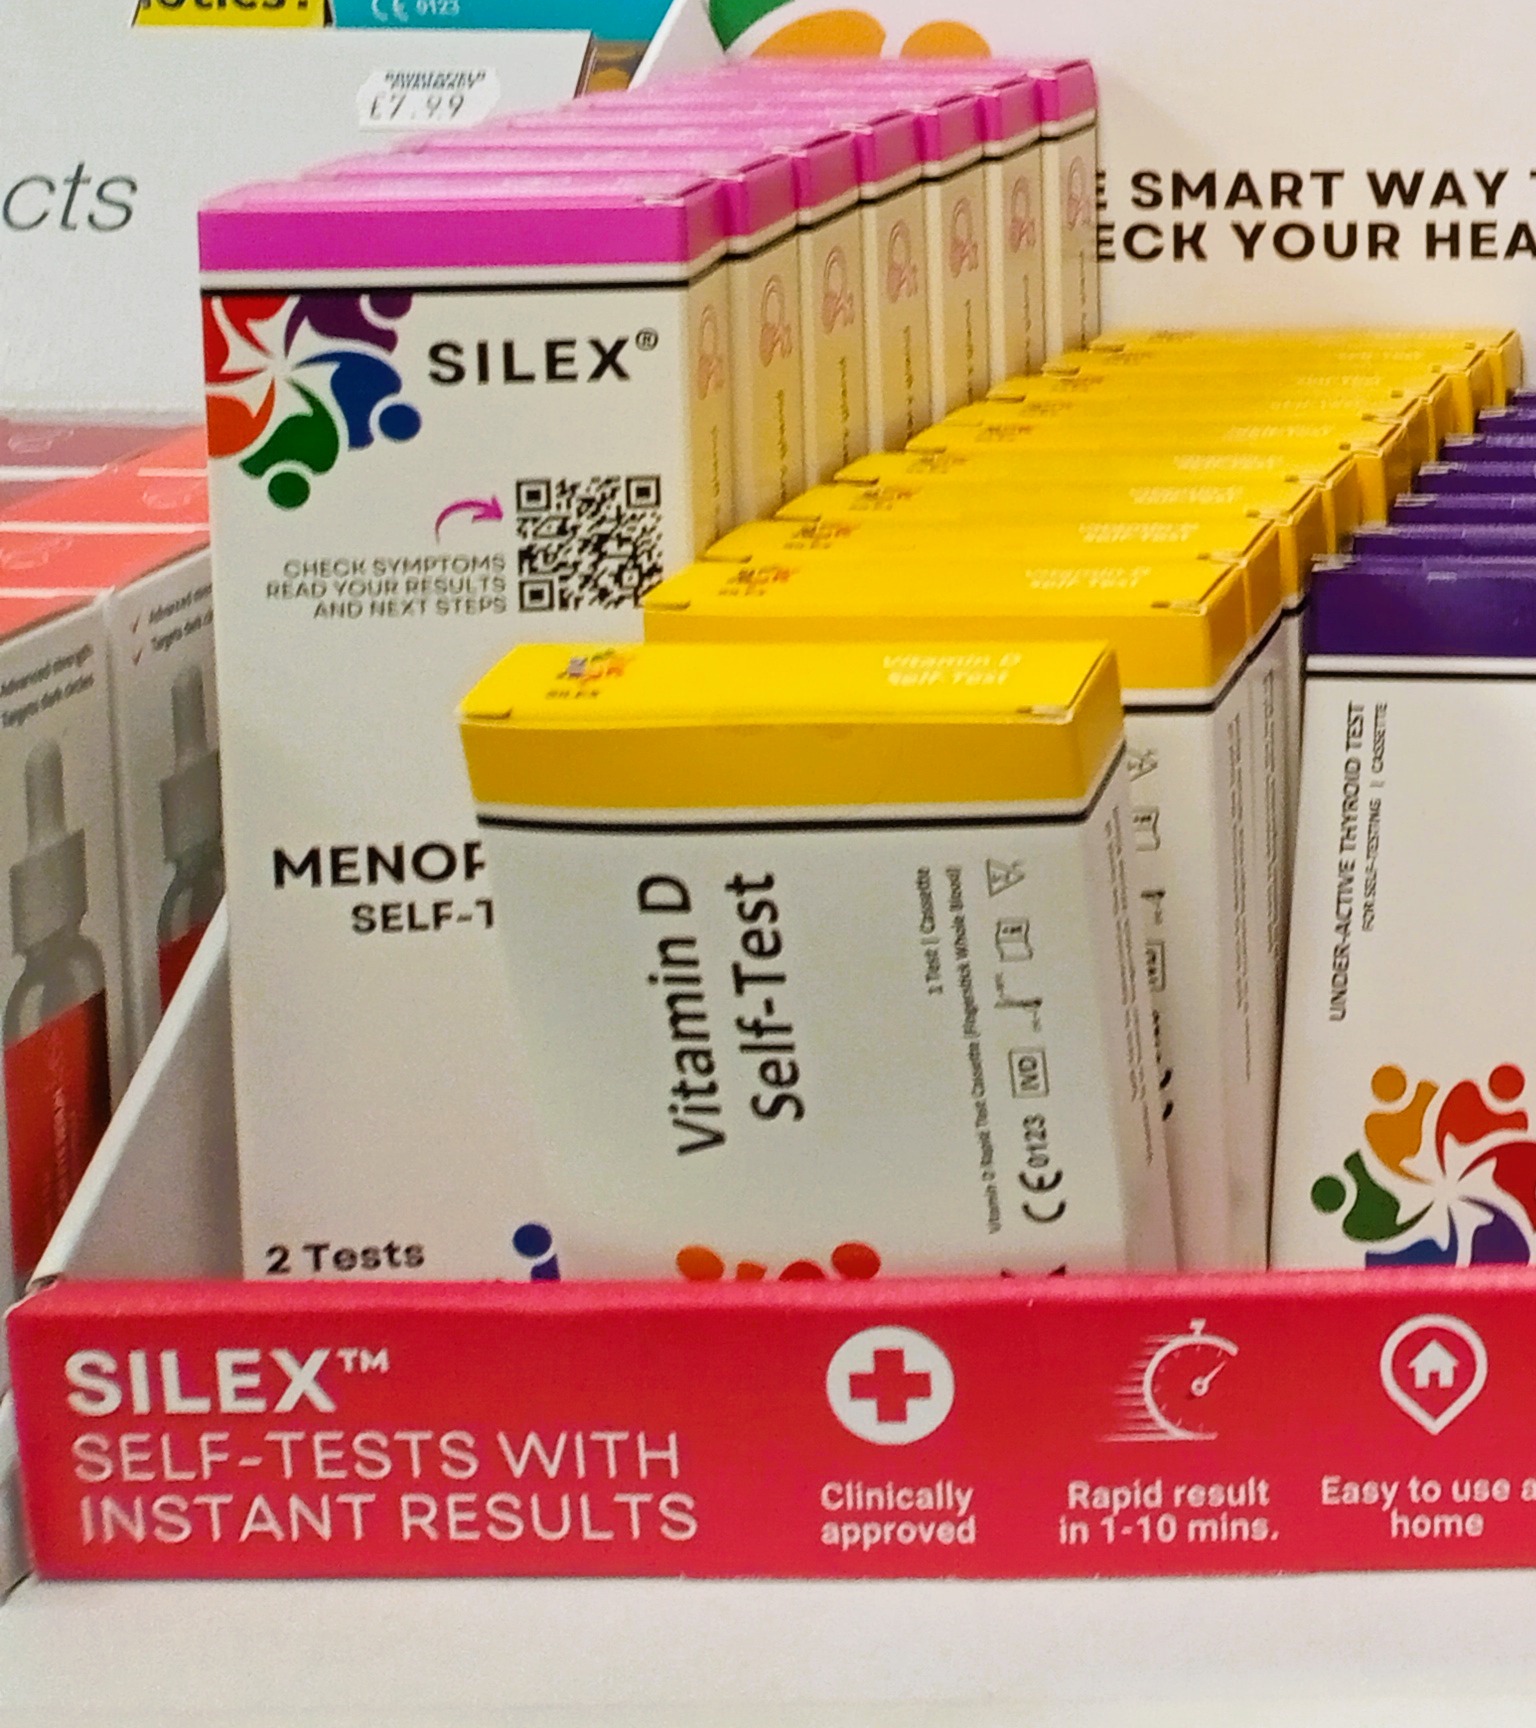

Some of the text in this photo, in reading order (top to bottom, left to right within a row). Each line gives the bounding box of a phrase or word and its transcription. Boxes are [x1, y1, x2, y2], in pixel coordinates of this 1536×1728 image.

[368, 94, 466, 121] £7.99
[2, 160, 138, 233] cts
[1130, 168, 1346, 212] SMART
[1368, 168, 1508, 209] WAY
[1232, 220, 1400, 262] YOUR
[282, 554, 506, 580] CHECK SYMPTOMS
[266, 576, 506, 601] READ YOUR RESULTS
[313, 596, 507, 620] AND NEXT STEPS
[1327, 700, 1367, 1024] UNDER-ACTIVE THYROID TEST
[637, 873, 728, 1157] Vitamin D
[724, 871, 807, 1123] Self-Test
[1021, 1111, 1052, 1170] 0123
[265, 1237, 426, 1275] 2 Tests
[73, 1429, 681, 1483] SELF-TESTS WITH
[820, 1479, 974, 1518] Clinically
[1066, 1478, 1270, 1518] Rapid result
[1321, 1475, 1399, 1511] Easy
[1407, 1475, 1443, 1503] to
[1449, 1478, 1512, 1504] use
[80, 1491, 697, 1545] INSTANT RESULTS
[820, 1516, 977, 1552] approved
[1058, 1516, 1281, 1544] in 1-10 mins.
[1390, 1509, 1484, 1539] home
